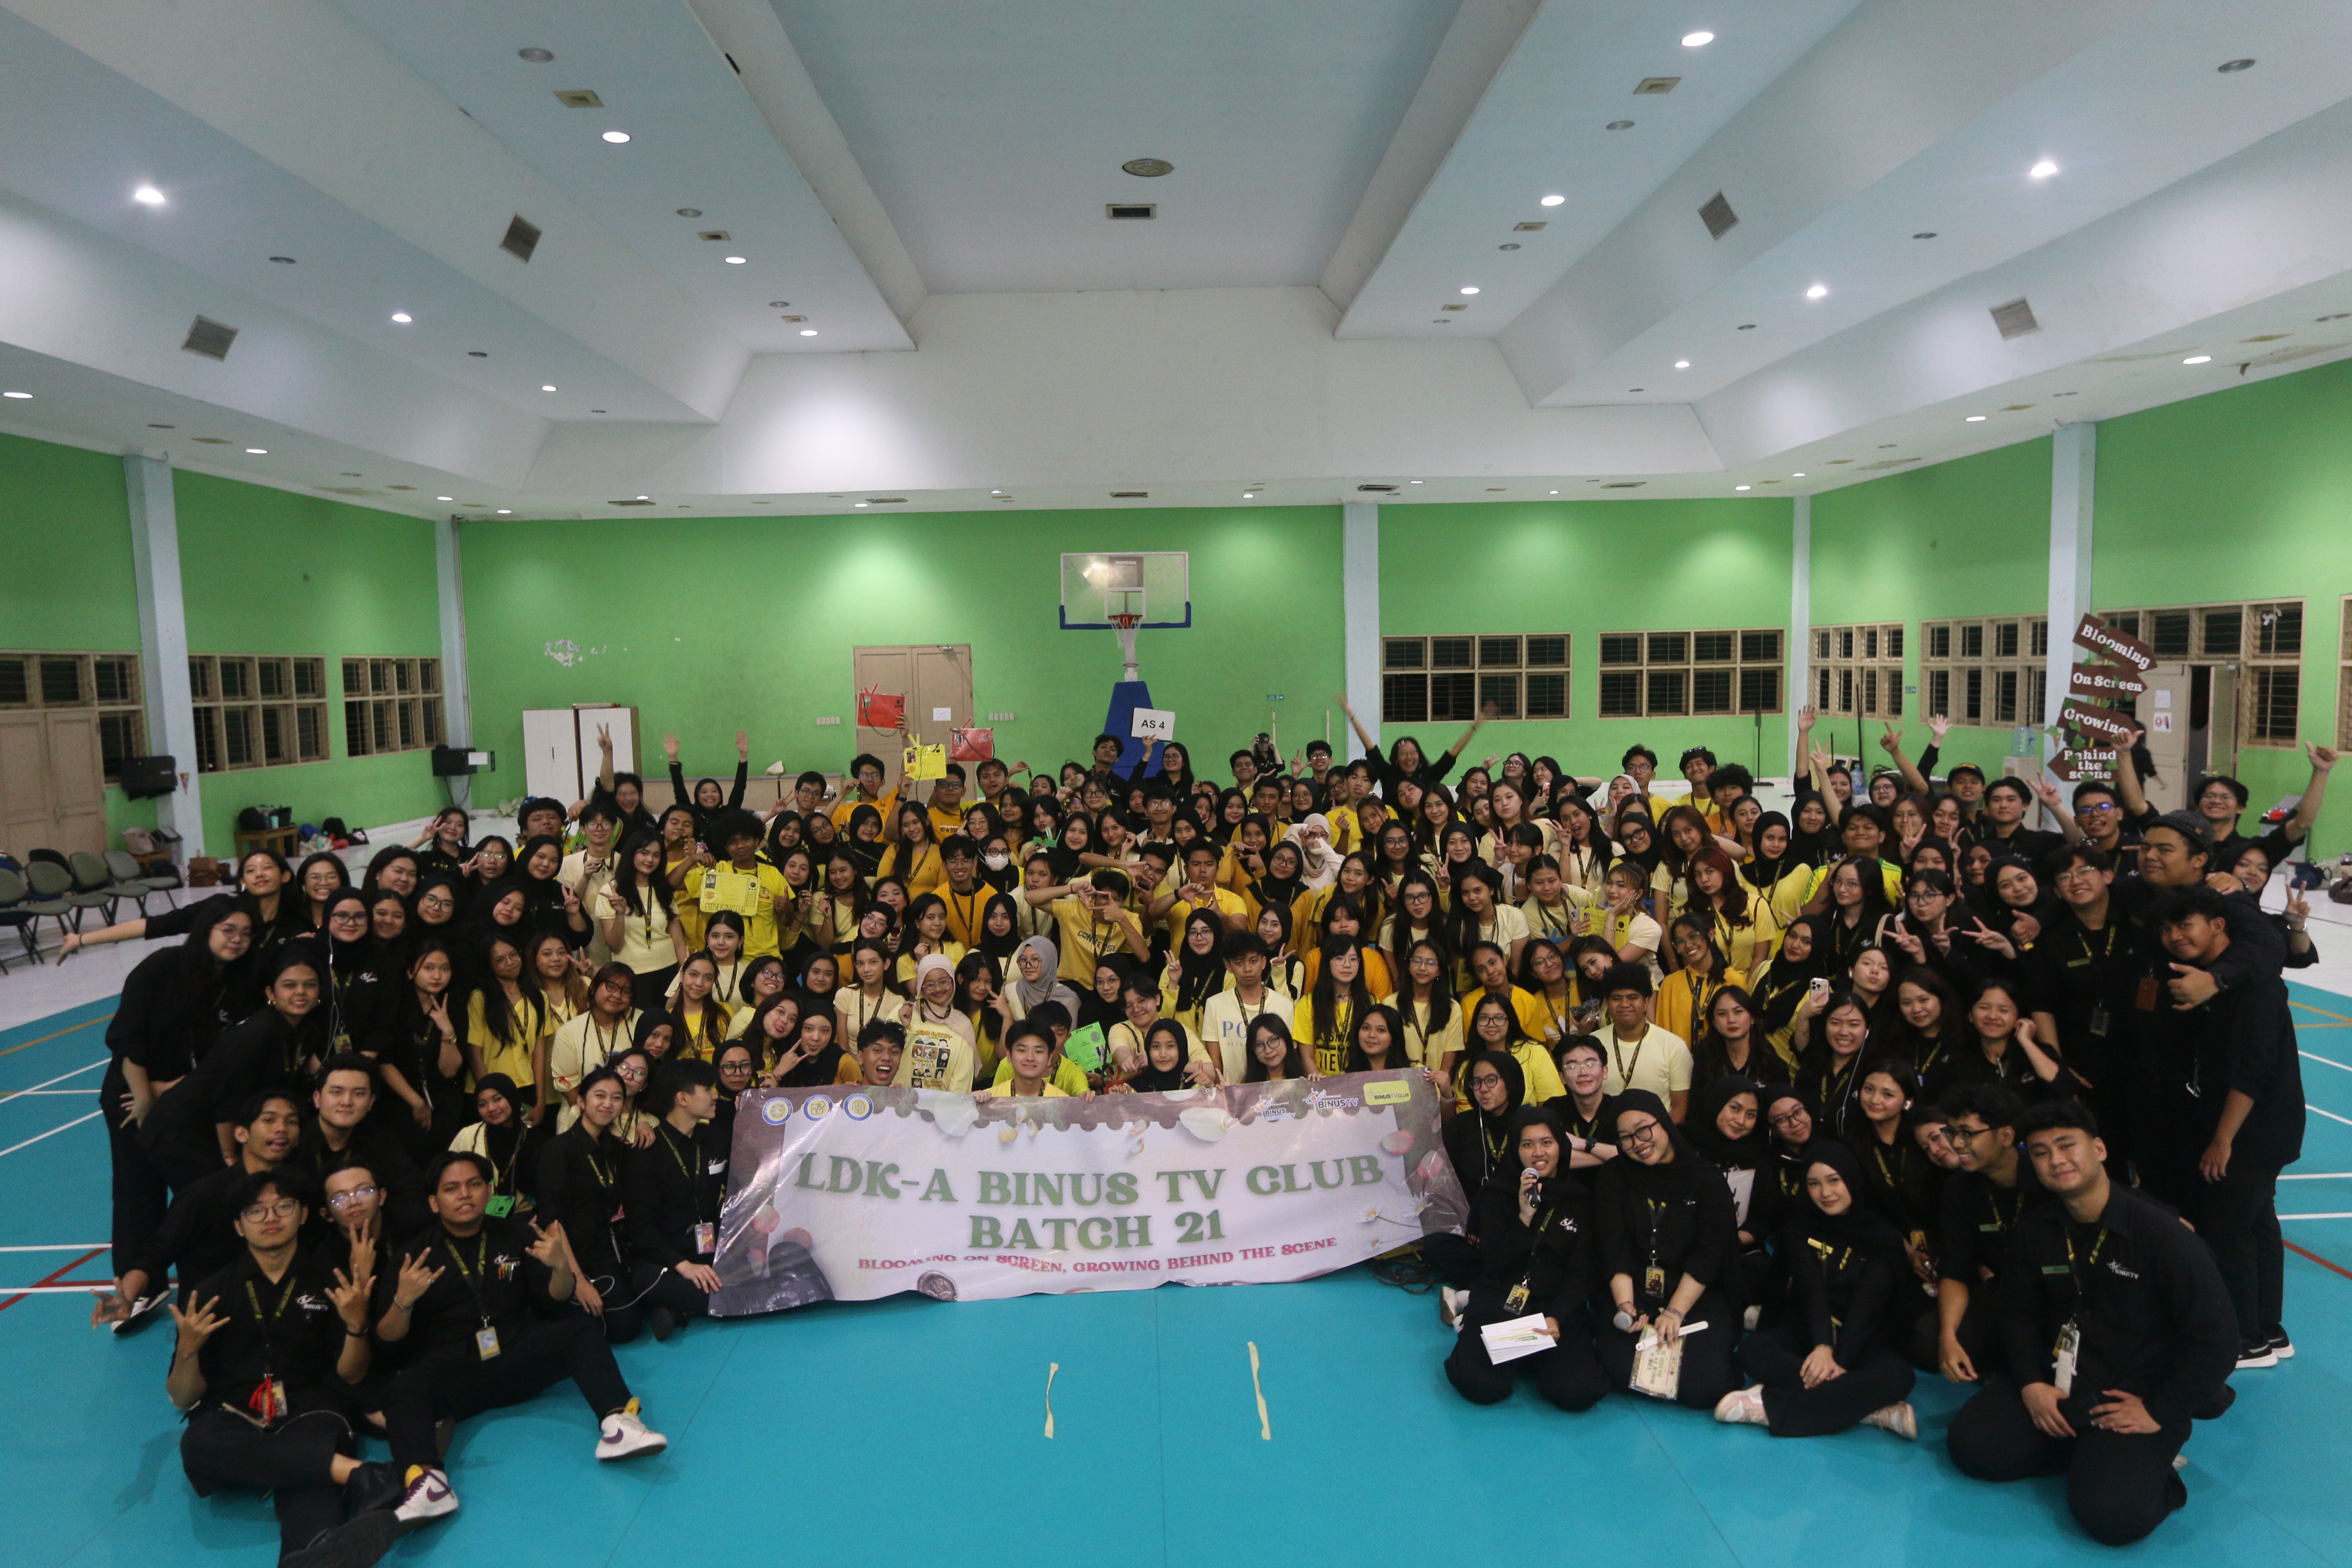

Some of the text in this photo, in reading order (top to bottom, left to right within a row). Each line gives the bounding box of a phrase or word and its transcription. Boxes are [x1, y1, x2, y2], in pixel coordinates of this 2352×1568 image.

[2081, 624, 2150, 670] Blooming
[2073, 673, 2092, 685] On
[1141, 720, 1165, 729] AS 4
[2078, 760, 2102, 770] the
[2069, 771, 2112, 779] scne
[1265, 1108, 1286, 1116] BINUS
[794, 1153, 1384, 1206] LDK-A BINUS TV CLUB
[968, 1209, 1225, 1251] BATCH 21
[859, 1255, 957, 1269] BLOOMING
[996, 1256, 1067, 1274] SCREEN,
[1073, 1260, 1160, 1272] GROWING
[1167, 1252, 1234, 1269] BEHIND
[1239, 1246, 1275, 1260] THE
[1281, 1237, 1337, 1256] SCENE
